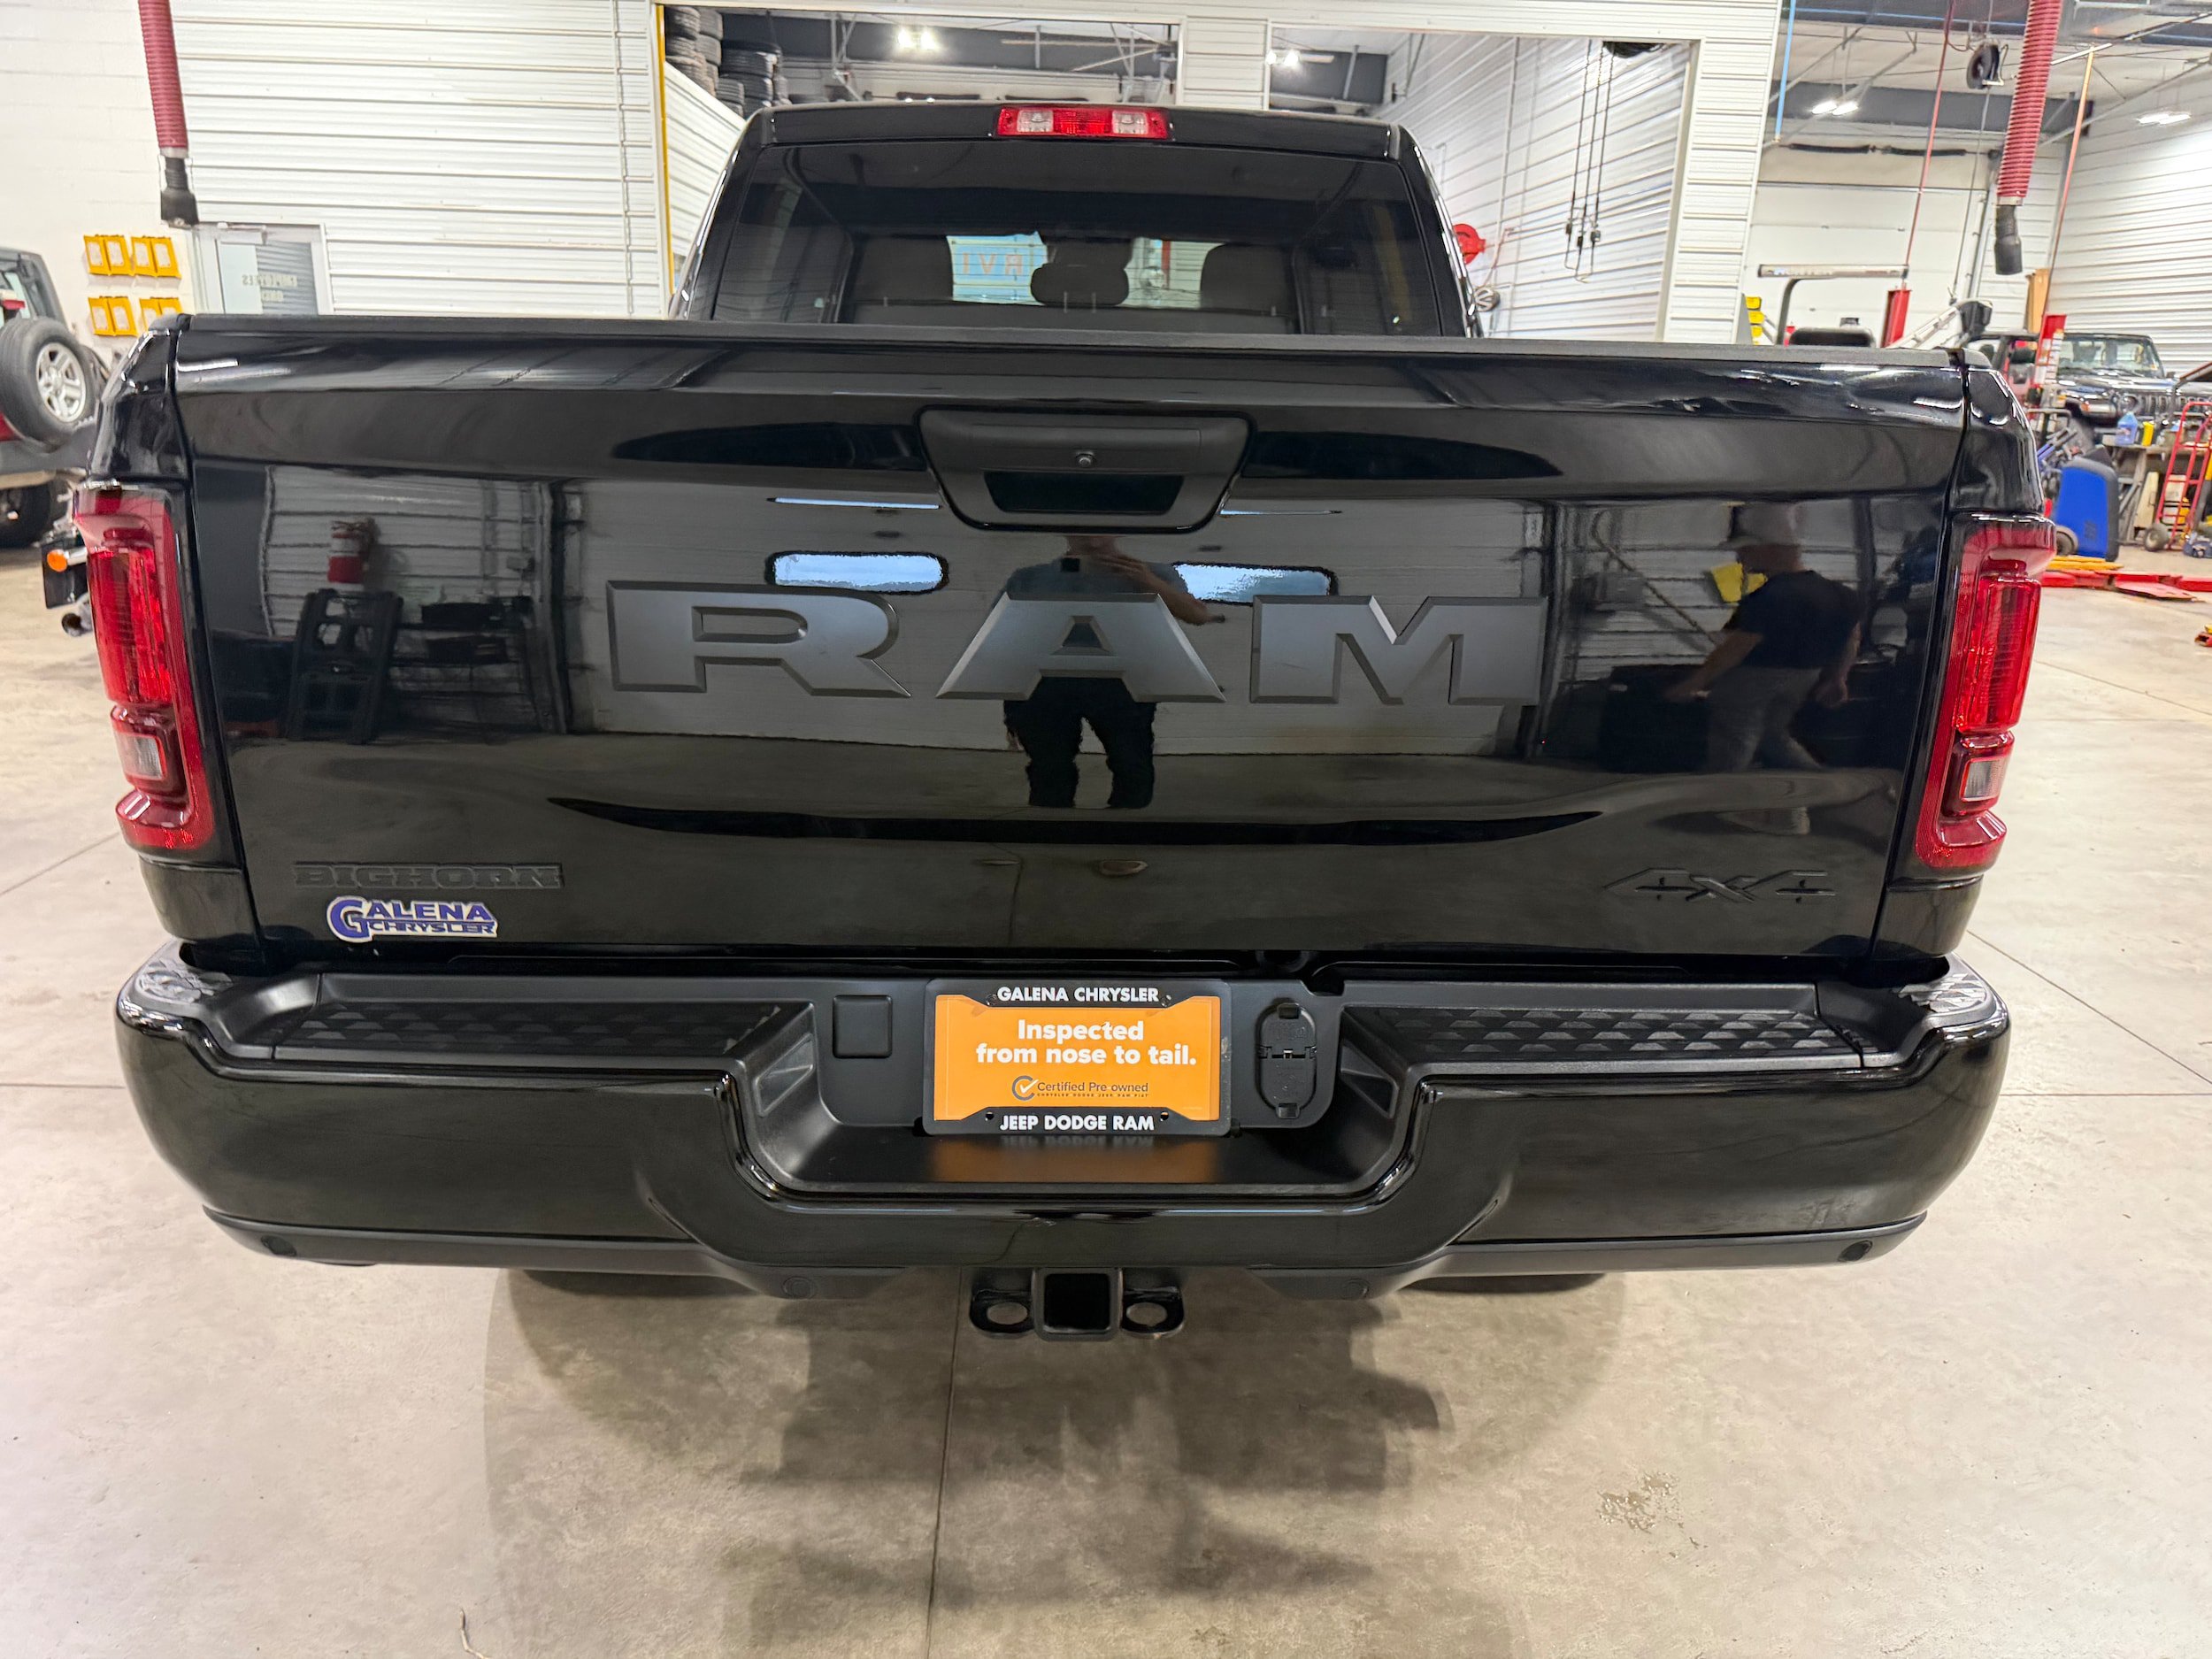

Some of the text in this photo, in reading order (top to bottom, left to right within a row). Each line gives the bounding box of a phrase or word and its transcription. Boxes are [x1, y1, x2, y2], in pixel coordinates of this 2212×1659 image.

[606, 580, 1548, 704] RAM
[329, 898, 491, 939] GALENA
[368, 920, 495, 934] CHRYSLER
[996, 986, 1160, 1002] GALENA CHRYSLER
[1018, 1019, 1145, 1045] Inspected
[975, 1042, 1197, 1065] from nose to tail.
[1037, 1081, 1086, 1093] Certified
[999, 1114, 1156, 1132] JEEP DODGE RAM
